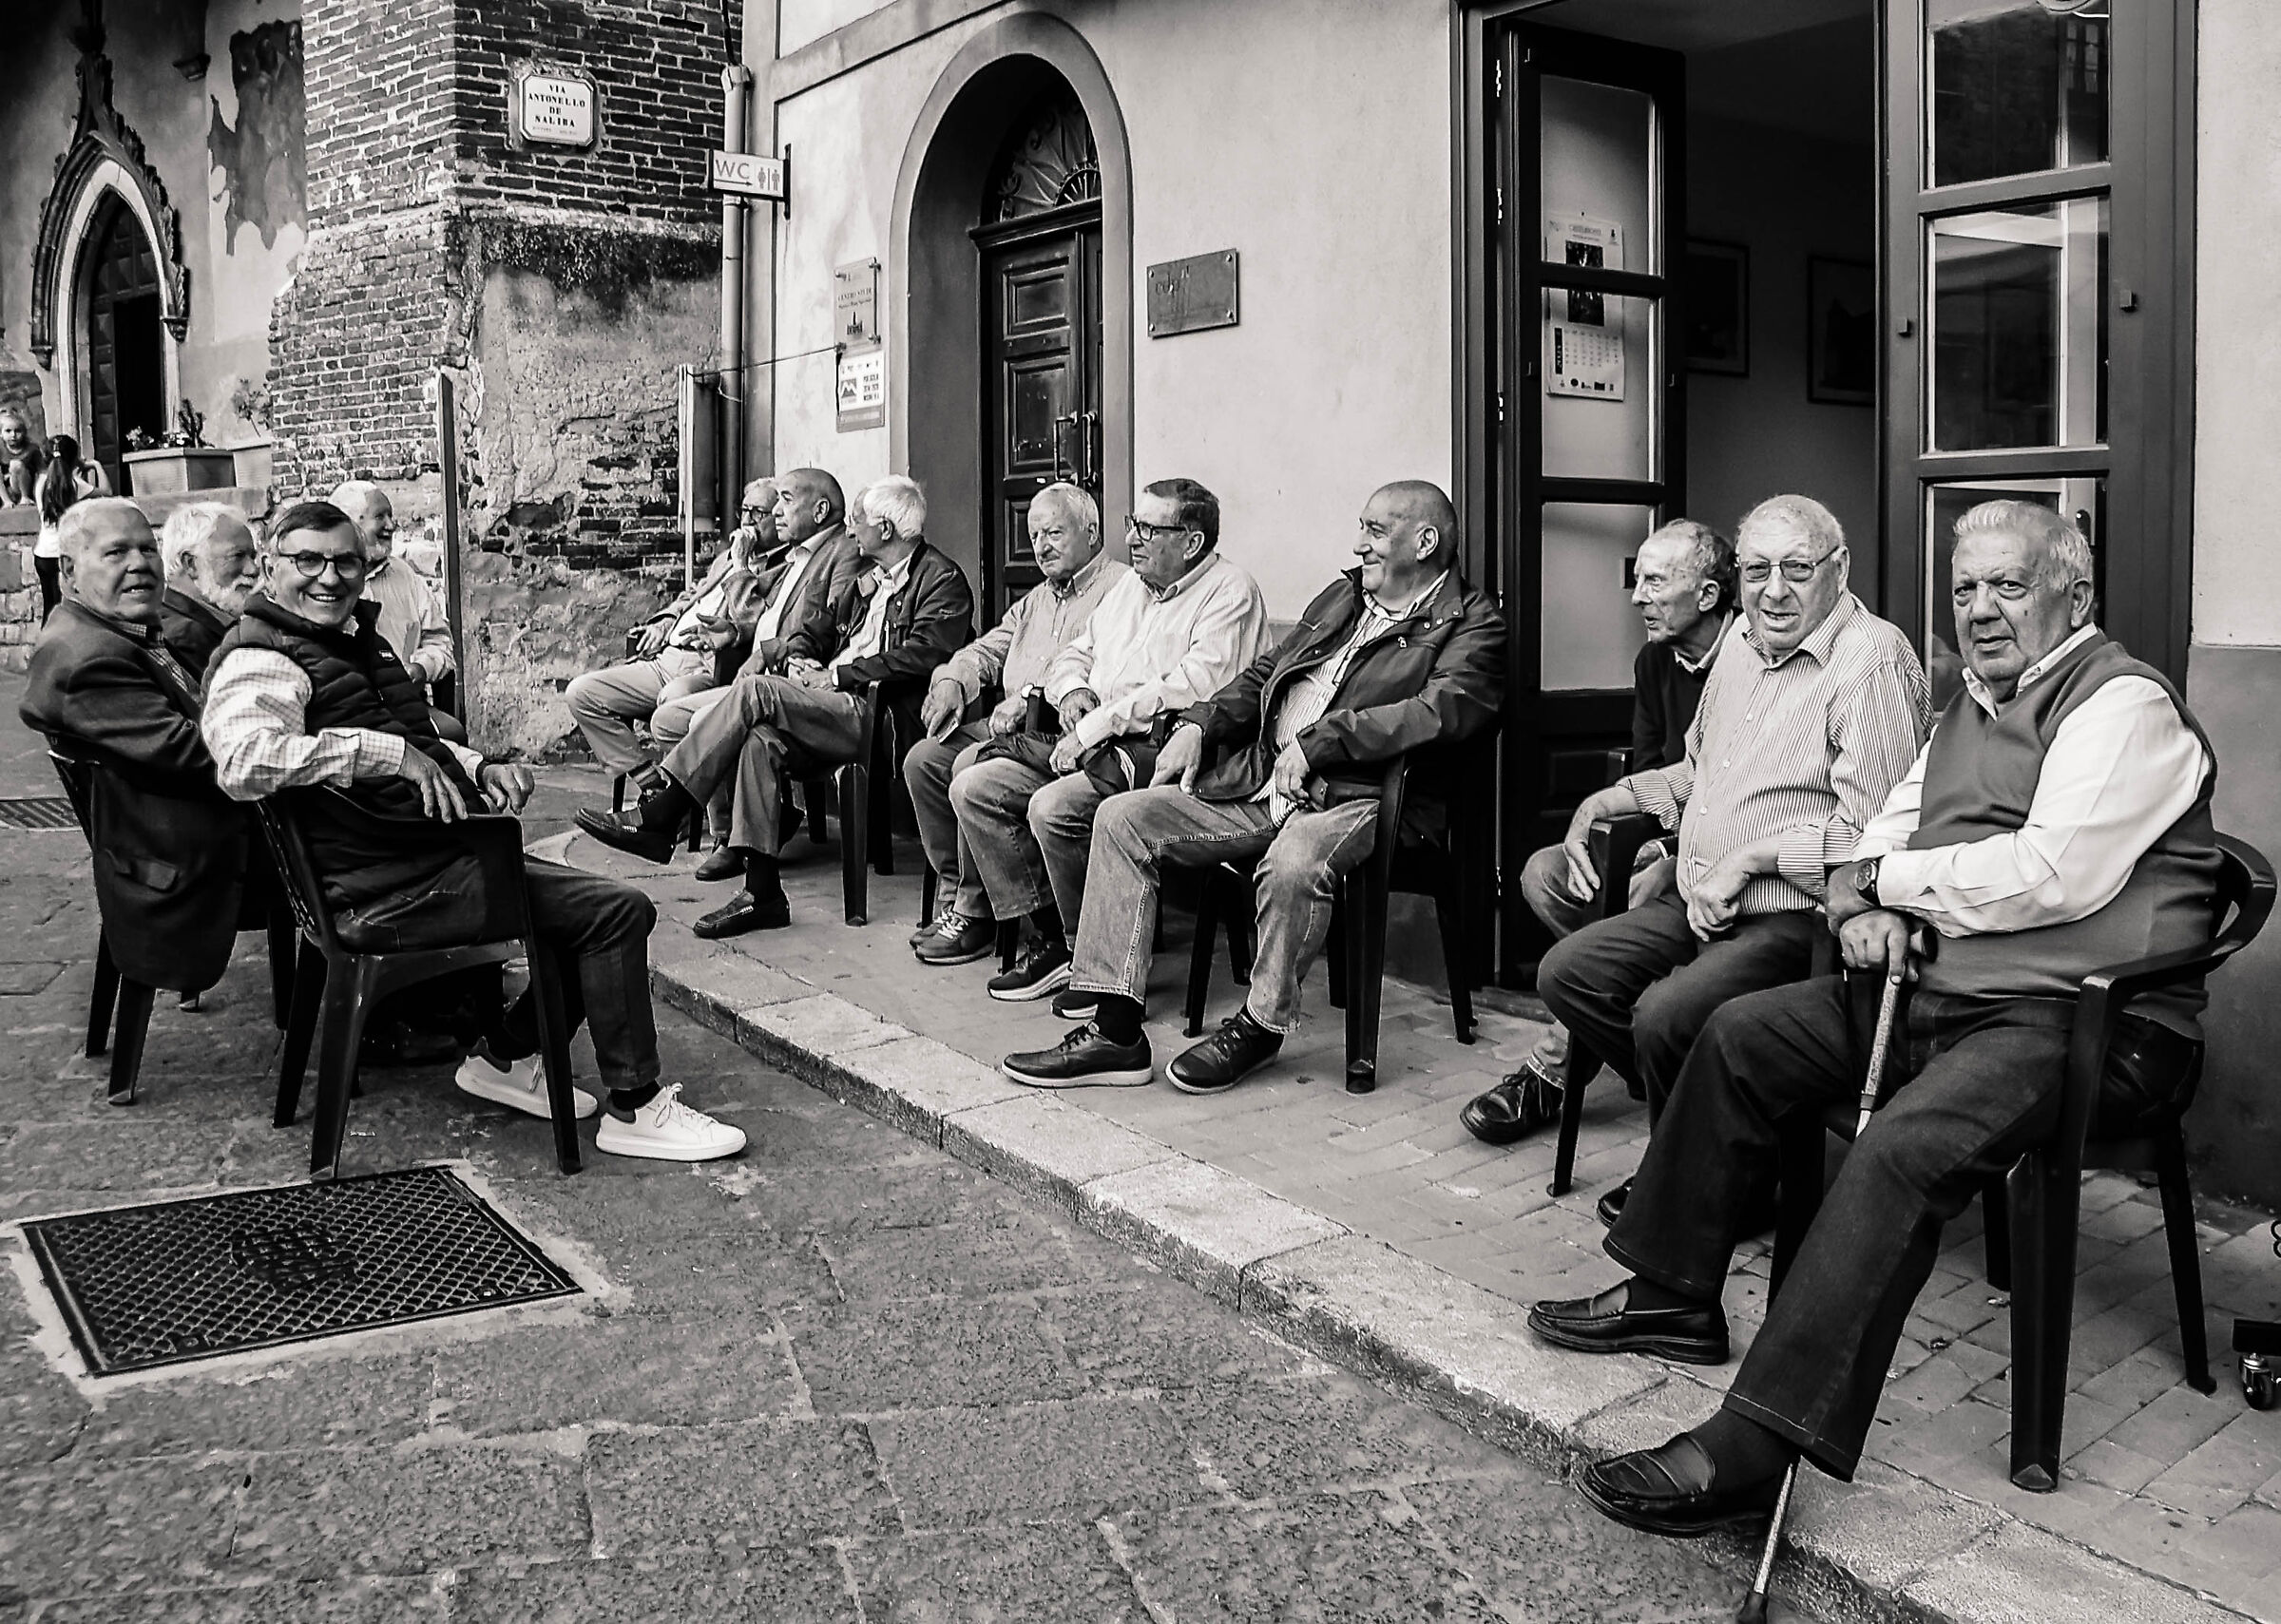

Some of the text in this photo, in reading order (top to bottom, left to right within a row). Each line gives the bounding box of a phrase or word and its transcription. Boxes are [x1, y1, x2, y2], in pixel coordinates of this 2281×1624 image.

[549, 85, 565, 94] VIA
[528, 93, 585, 107] ANTONELLO
[549, 106, 562, 115] DE
[715, 159, 750, 180] WC
